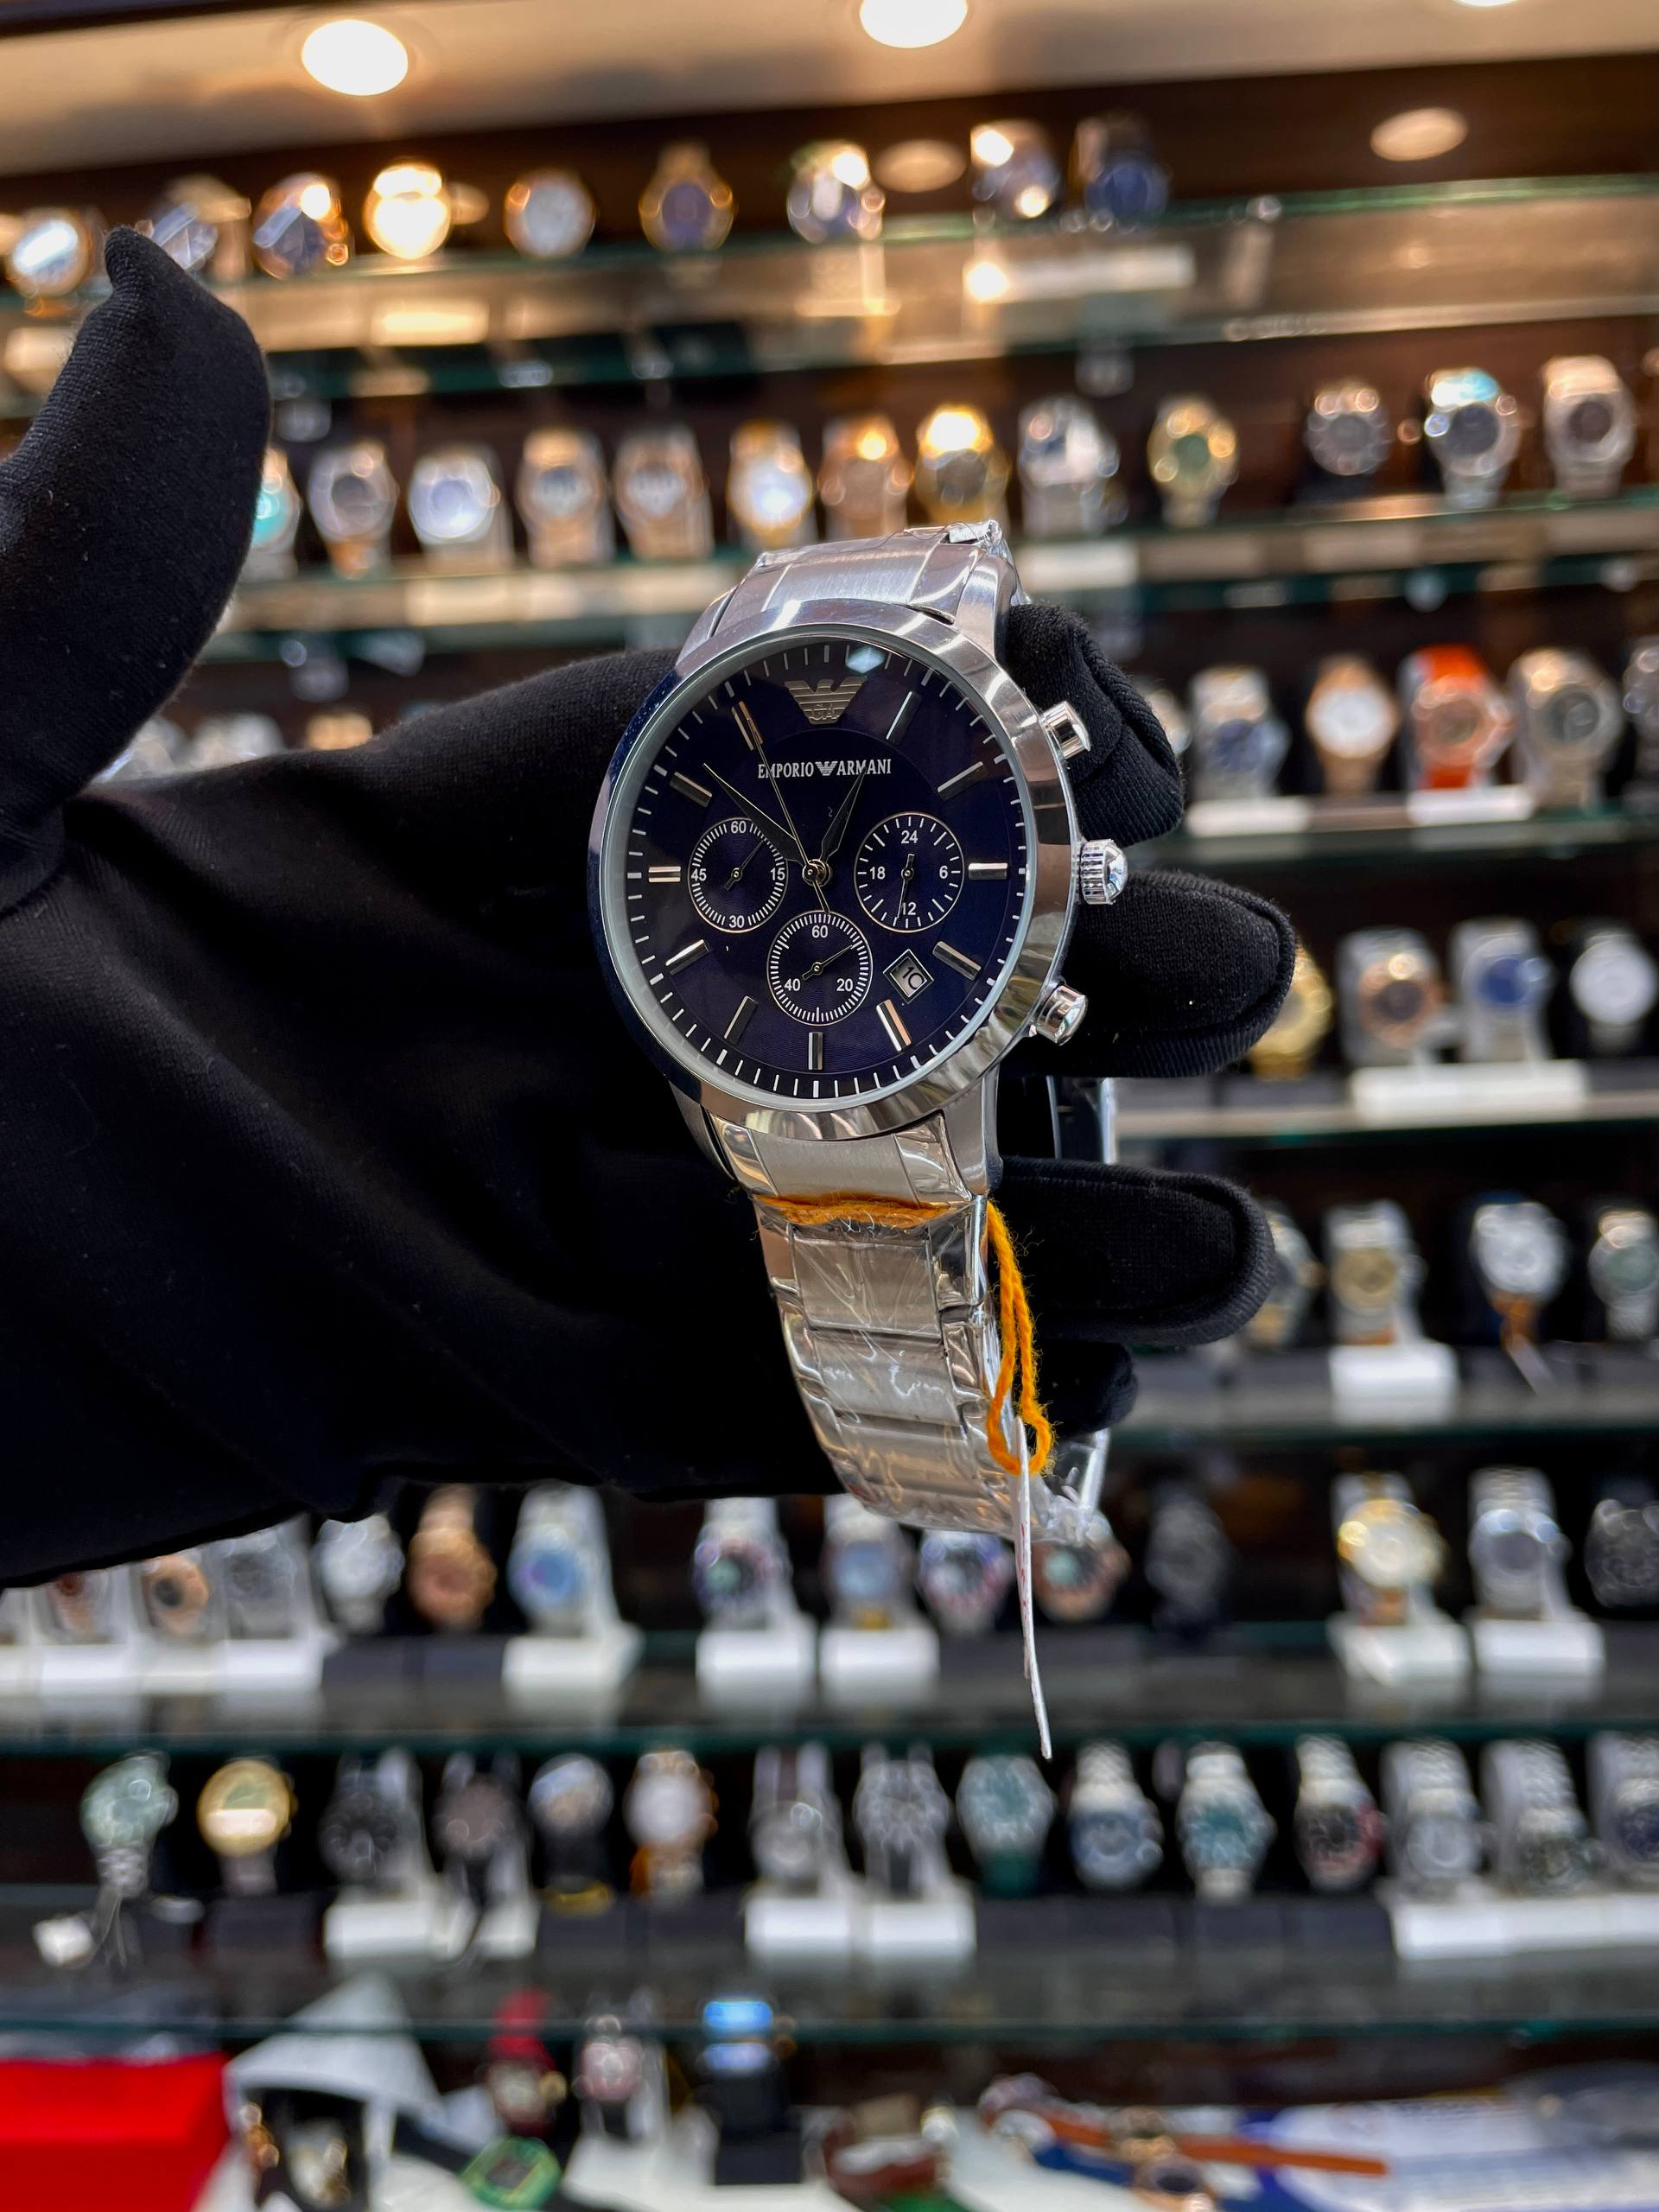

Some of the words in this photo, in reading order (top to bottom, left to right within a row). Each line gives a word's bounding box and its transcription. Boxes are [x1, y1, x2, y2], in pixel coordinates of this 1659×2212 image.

[757, 761, 815, 779] EMPORIO
[836, 759, 892, 776] ARMANI
[730, 820, 747, 834] 60
[900, 830, 918, 844] 24
[690, 868, 707, 882] 45
[770, 867, 785, 881] 15
[869, 866, 886, 880] 18
[938, 865, 949, 880] 6
[901, 901, 917, 916] 12
[728, 914, 745, 929] 30
[811, 925, 829, 938] 60
[784, 977, 801, 992] 40
[836, 977, 854, 992] 20
[902, 966, 925, 990] 10
